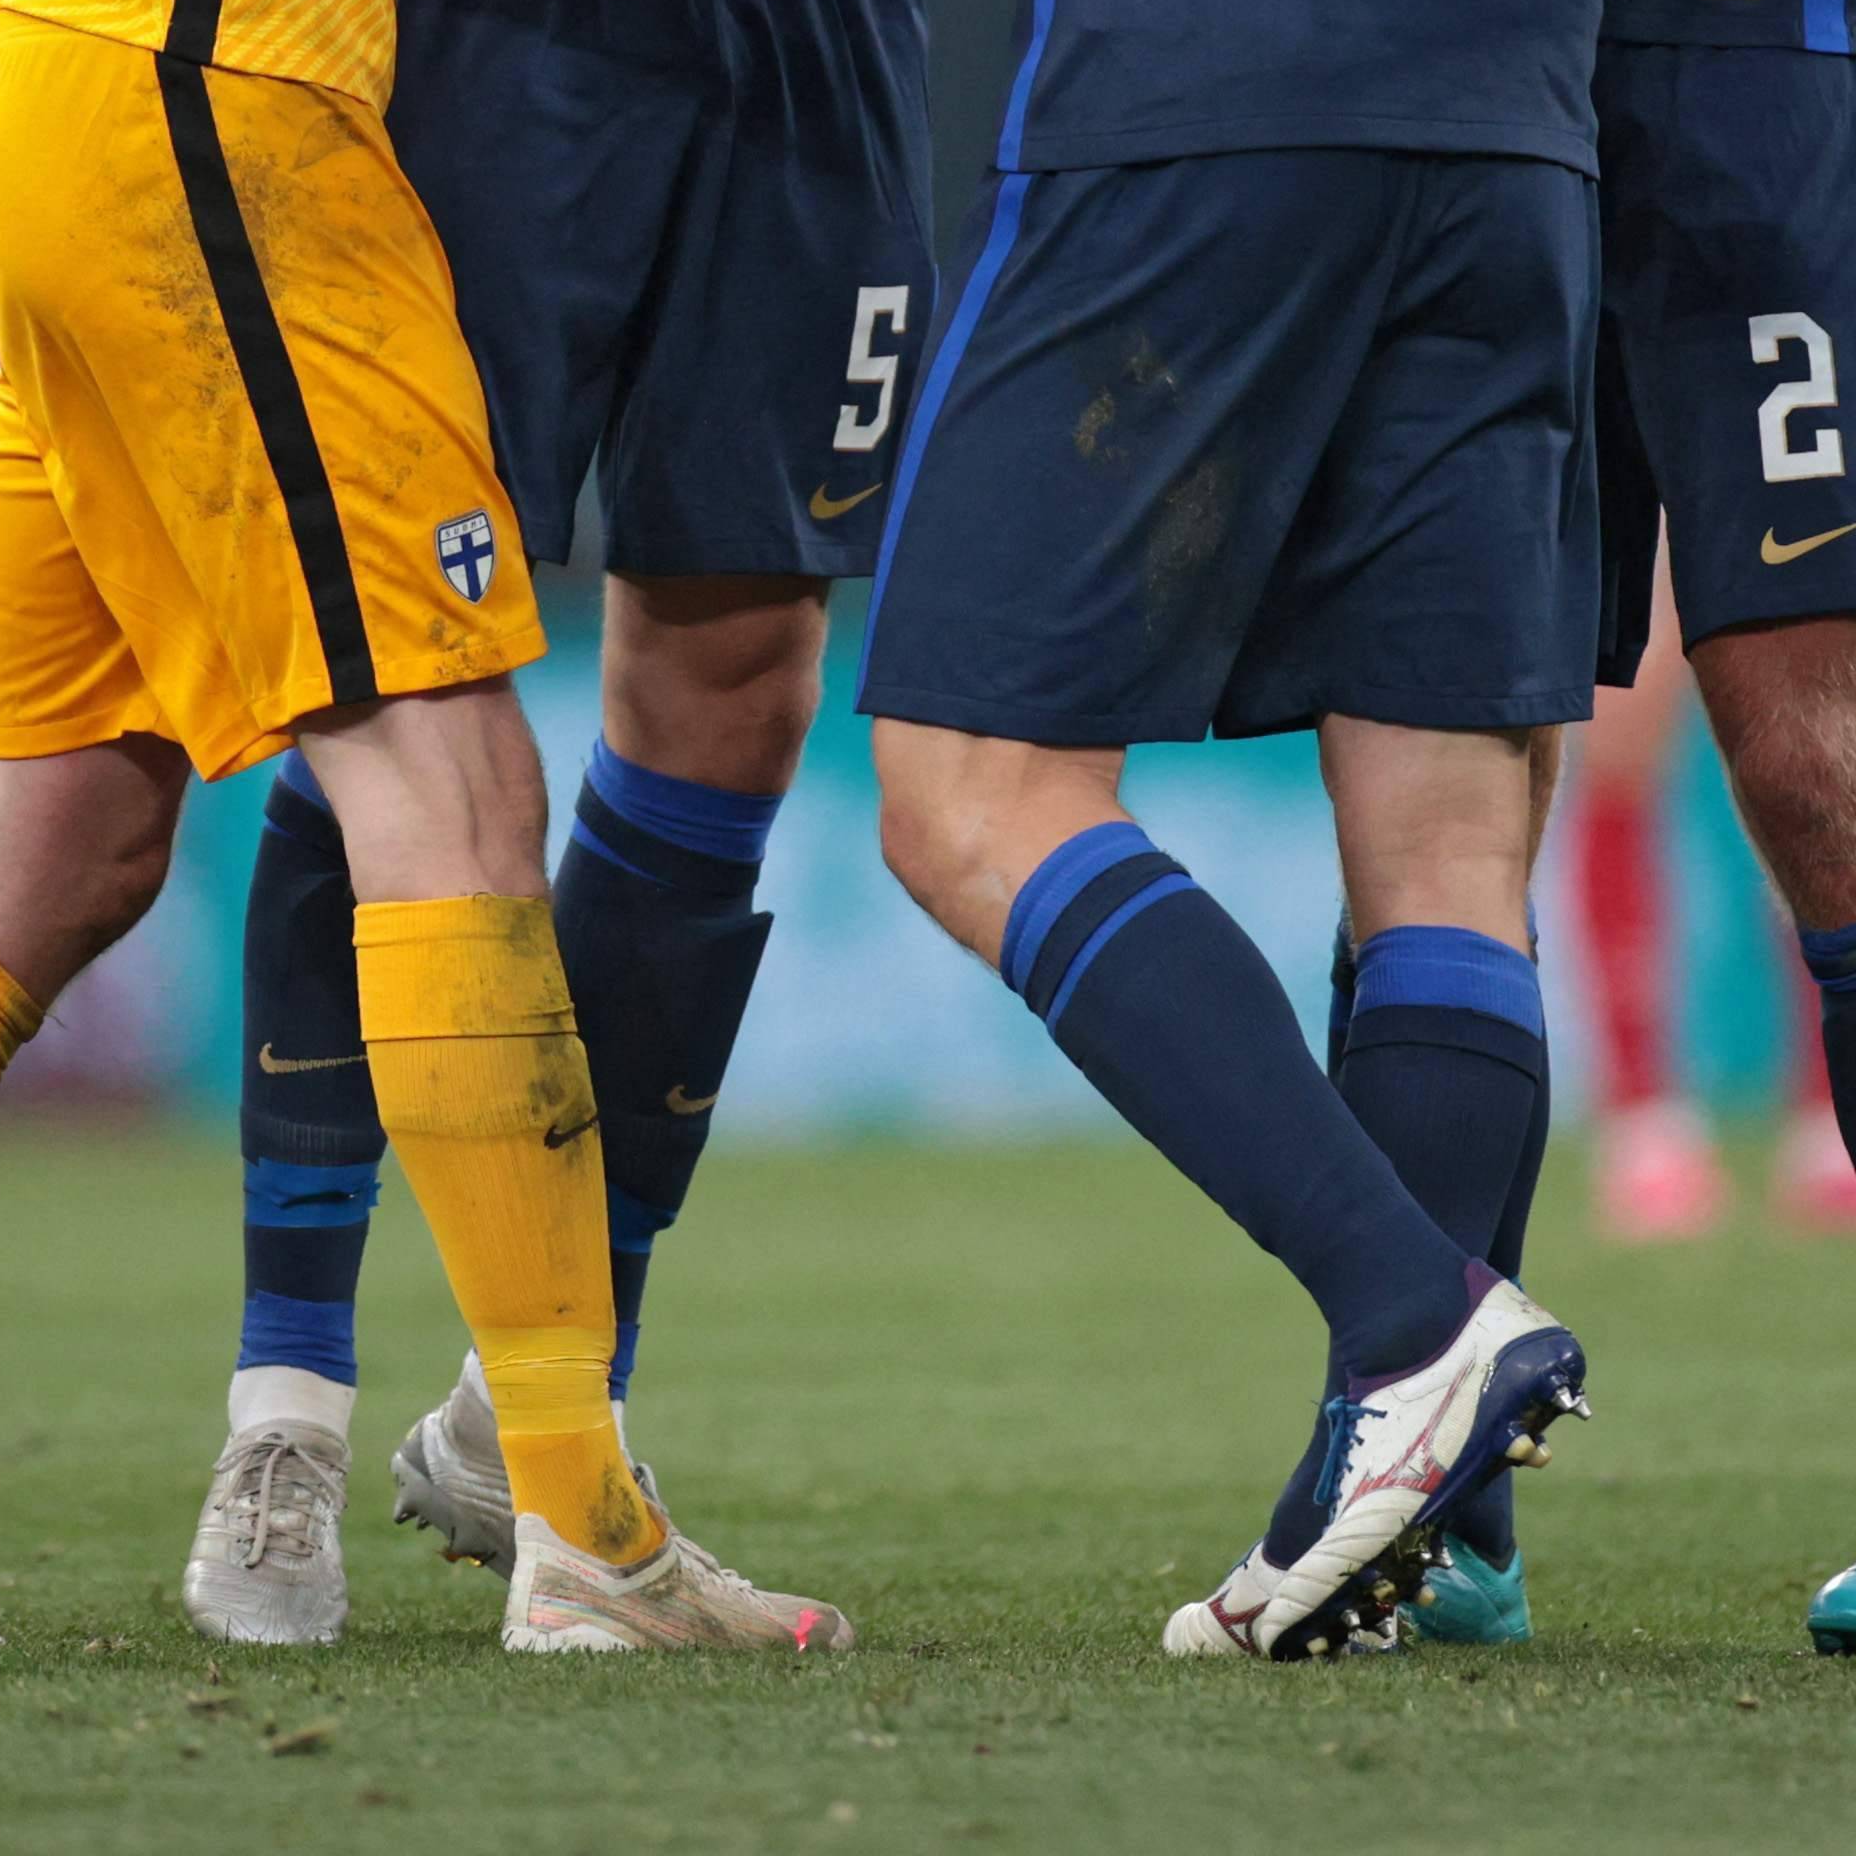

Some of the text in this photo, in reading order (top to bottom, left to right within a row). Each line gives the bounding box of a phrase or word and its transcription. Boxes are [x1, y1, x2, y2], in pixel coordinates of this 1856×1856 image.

[833, 285, 909, 452] 5
[1749, 311, 1846, 483] 2
[444, 519, 484, 537] SUOMI
